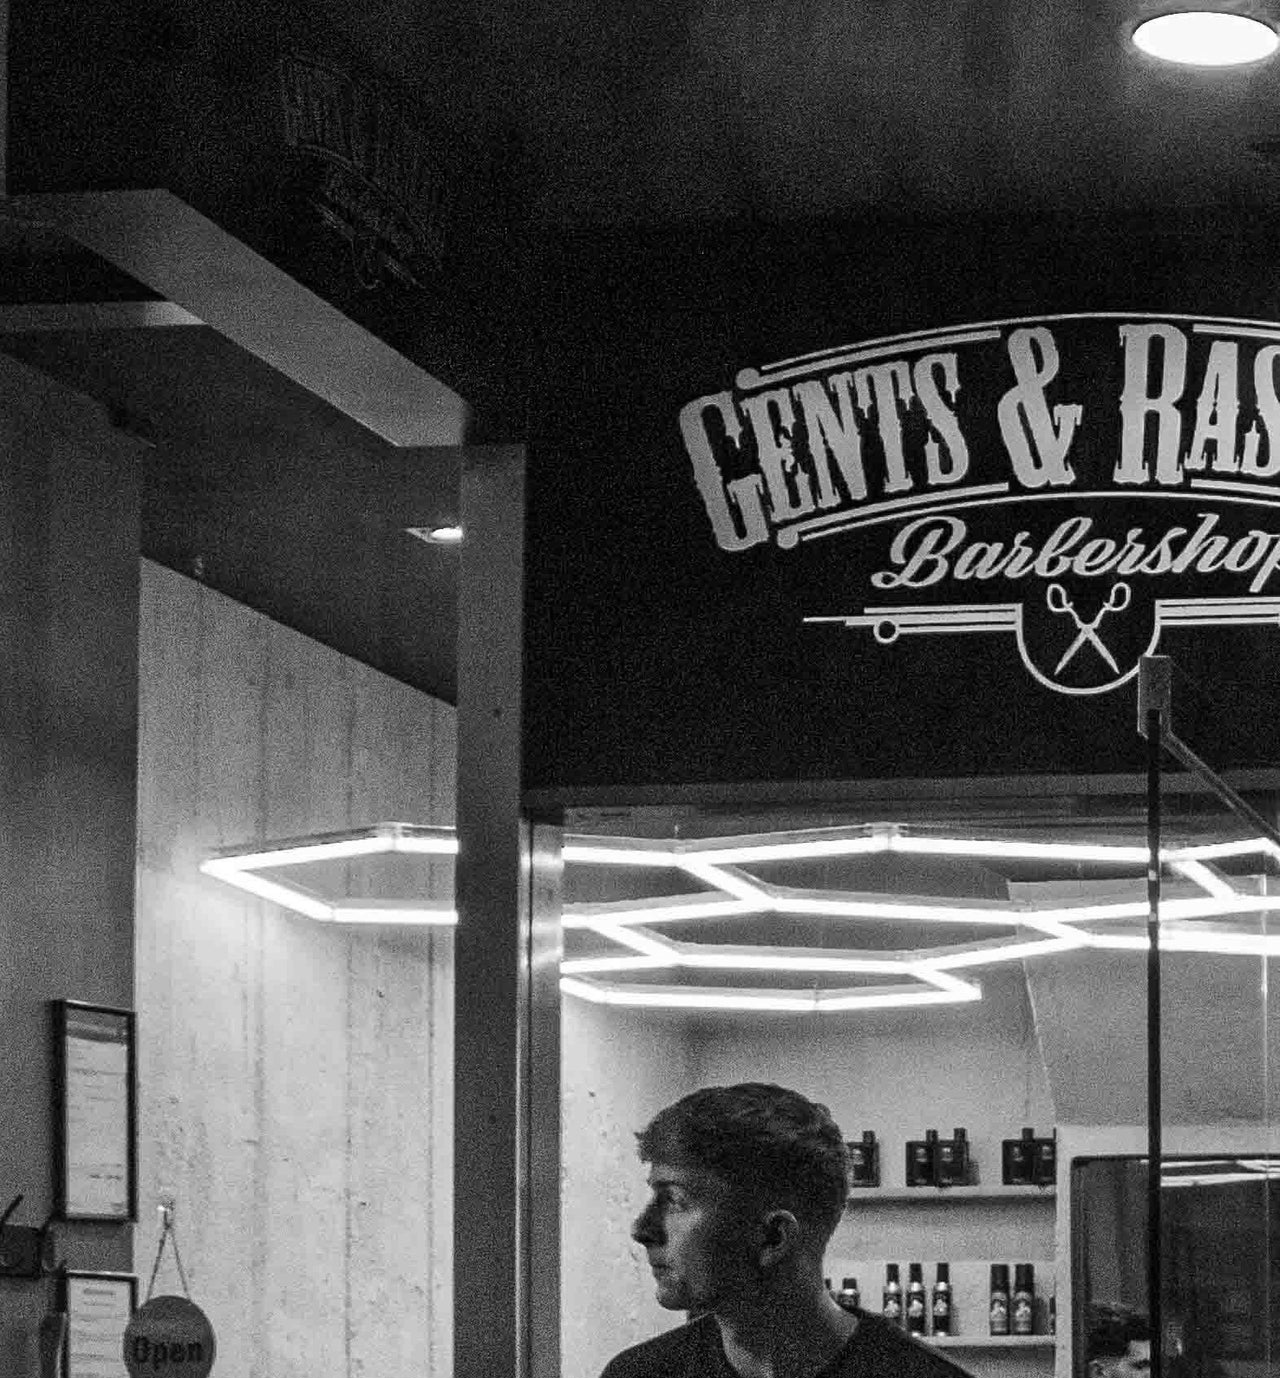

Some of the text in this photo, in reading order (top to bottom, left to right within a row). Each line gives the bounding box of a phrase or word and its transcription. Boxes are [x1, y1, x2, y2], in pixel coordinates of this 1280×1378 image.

[678, 350, 970, 553] GENTS
[997, 326, 1083, 488] &
[133, 1335, 203, 1372] Open
